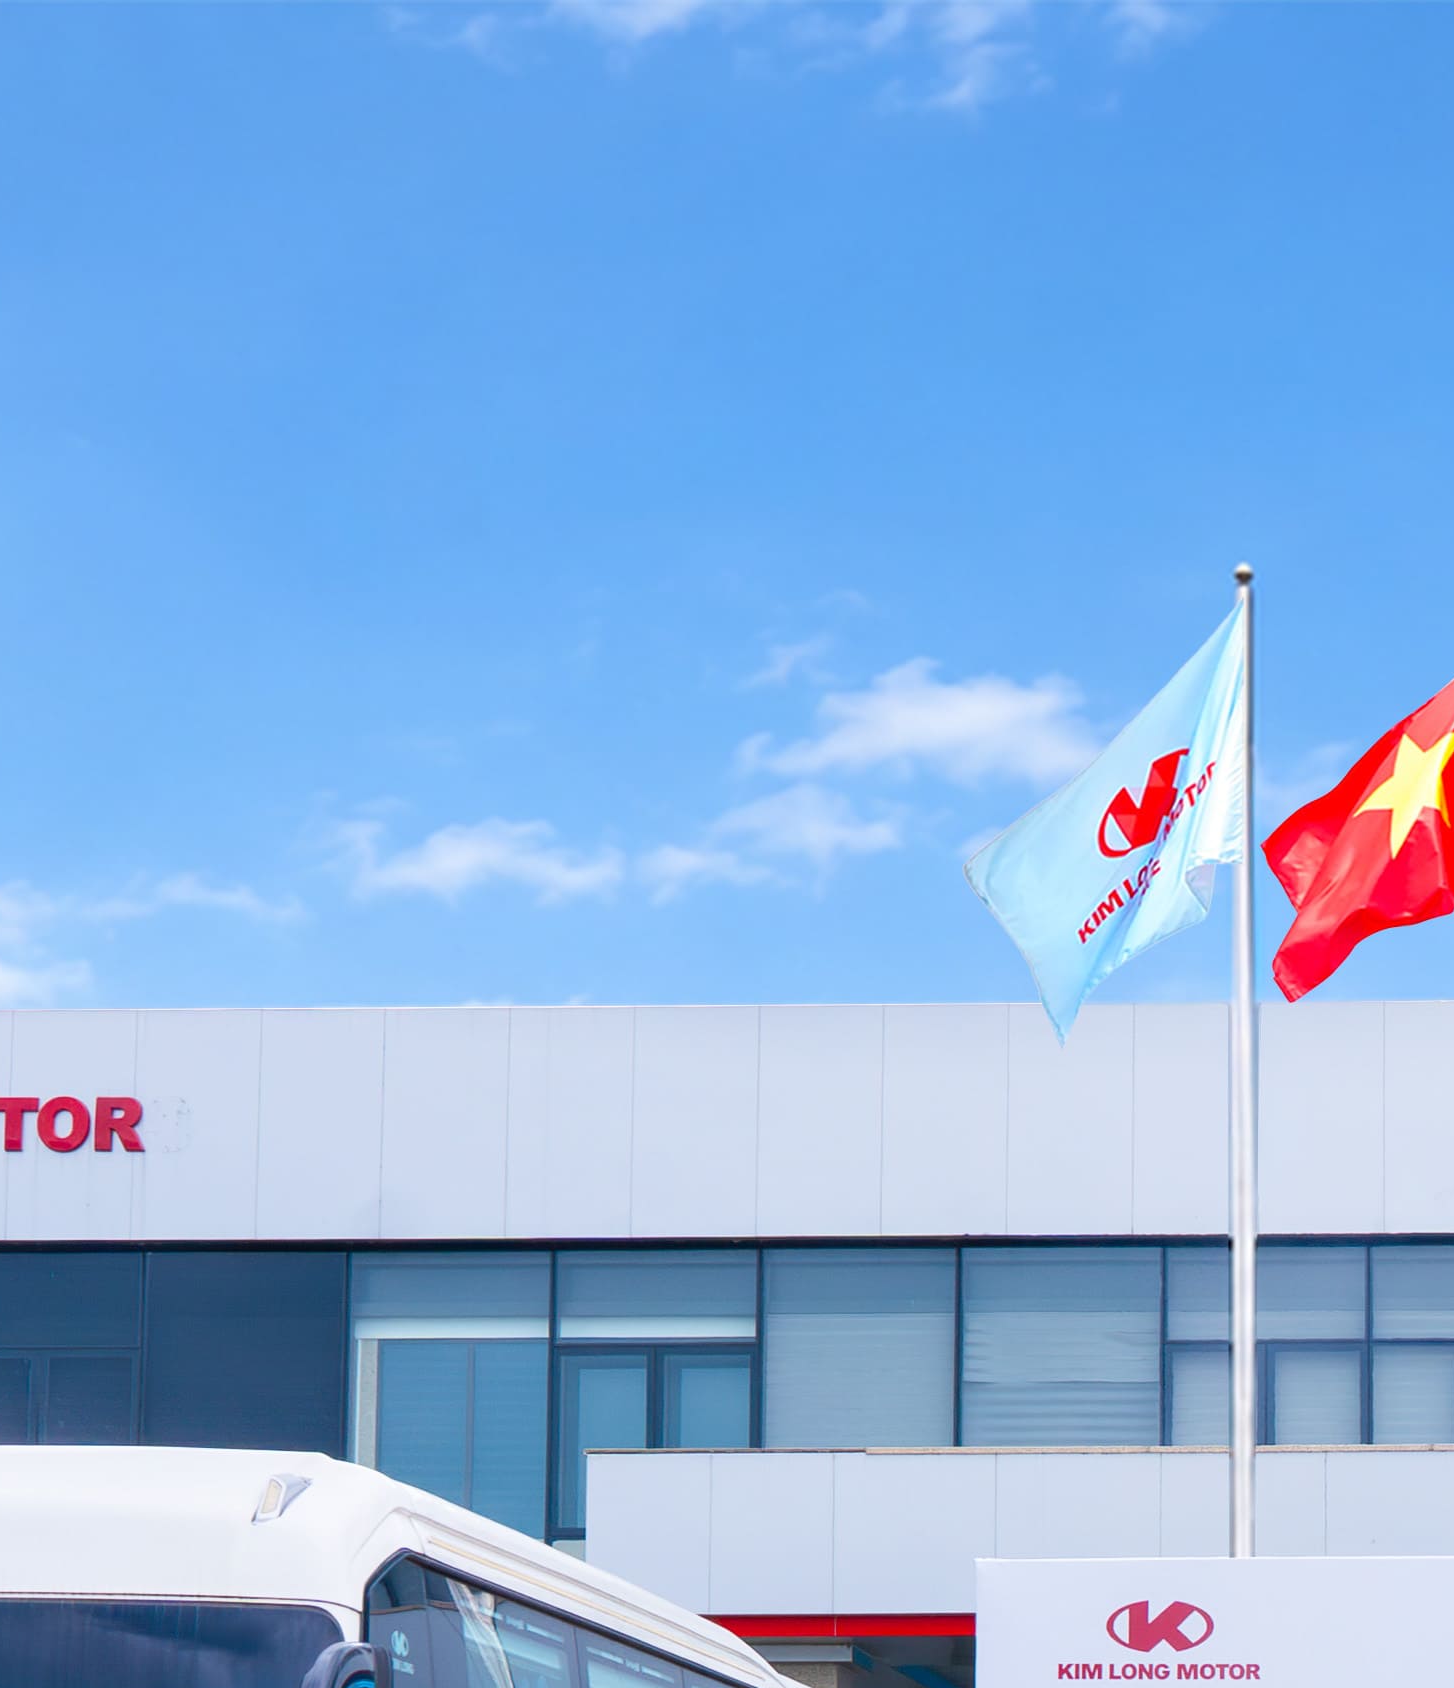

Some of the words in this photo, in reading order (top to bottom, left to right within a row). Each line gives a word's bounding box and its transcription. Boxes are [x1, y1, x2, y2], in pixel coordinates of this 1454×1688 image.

[1077, 888, 1125, 944] KIM
[1057, 1663, 1103, 1680] KIM
[1108, 1663, 1170, 1680] LONG
[1176, 1663, 1261, 1680] MOTOR
